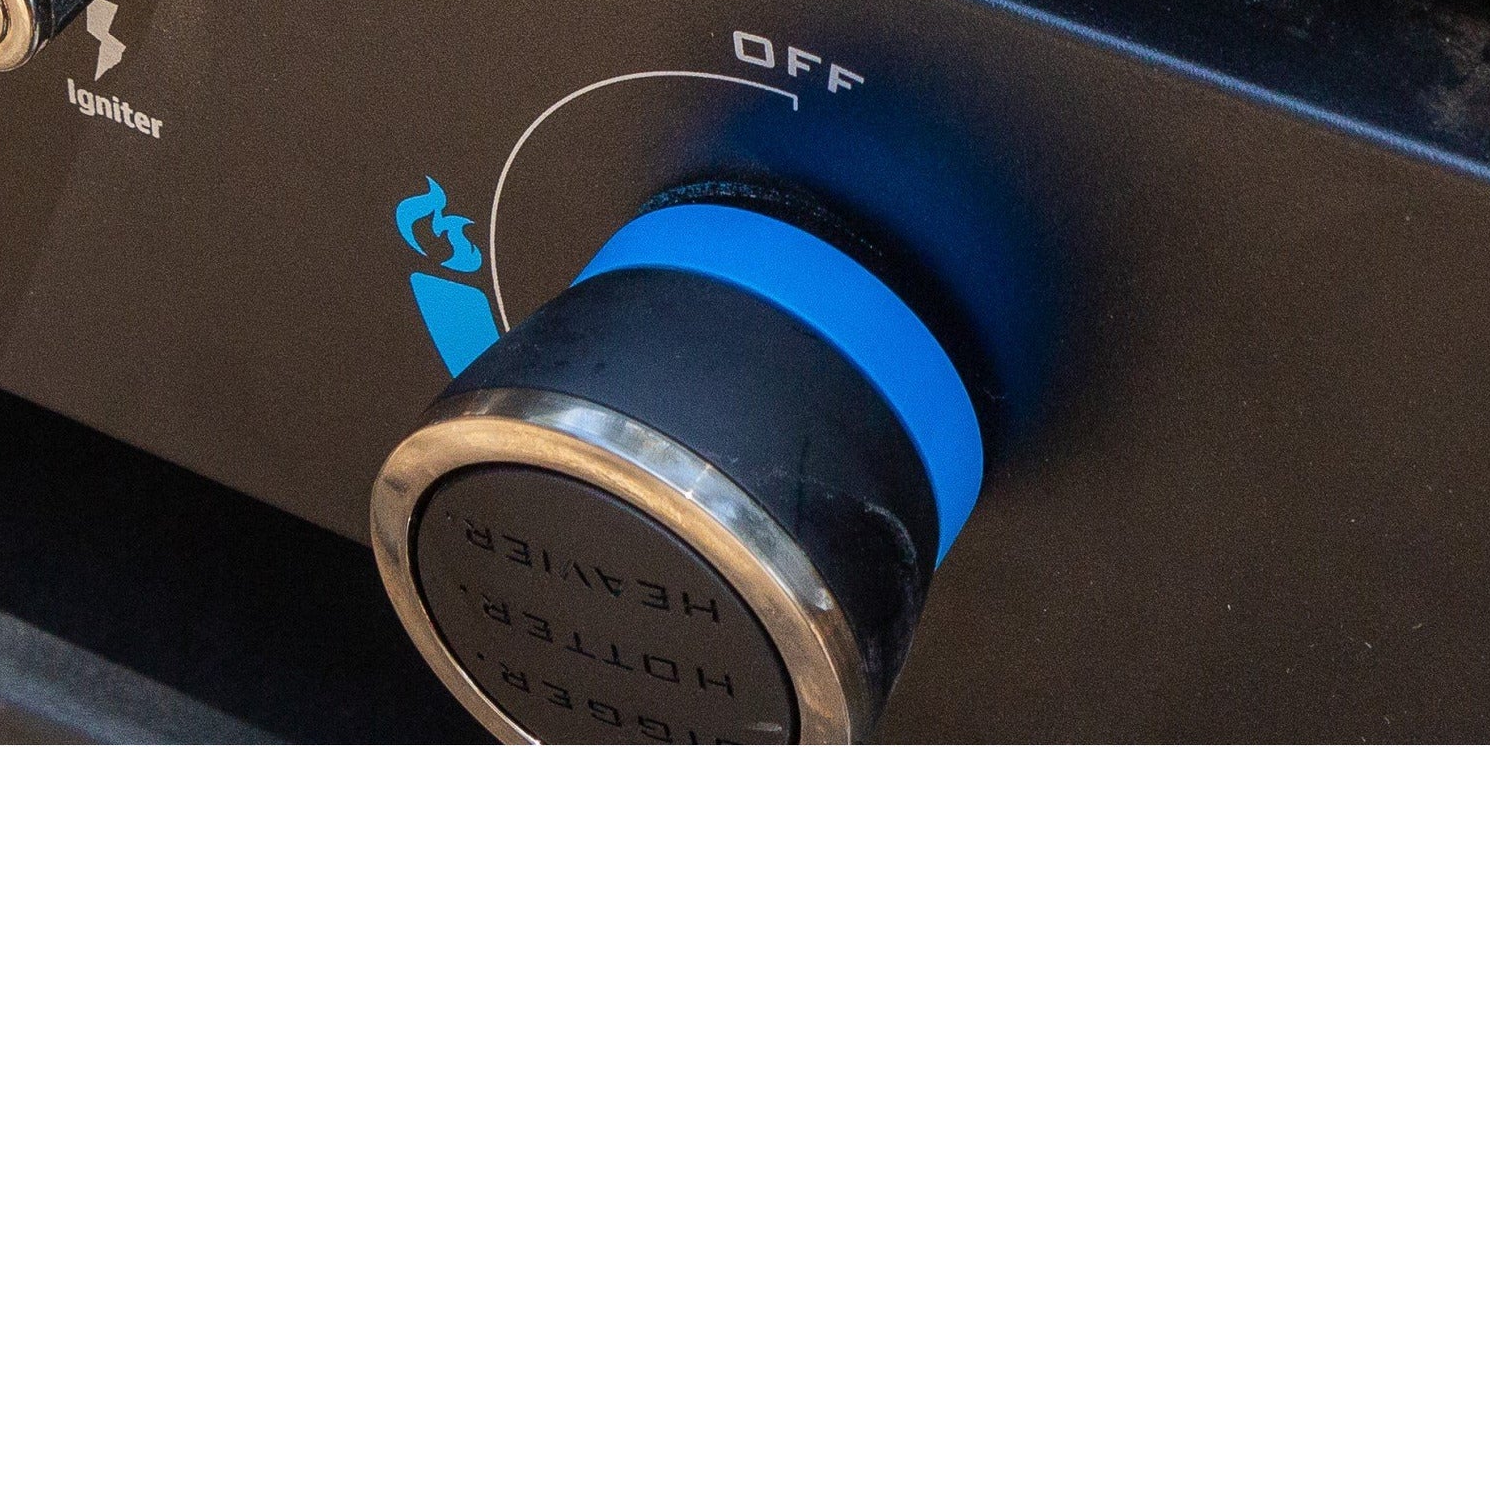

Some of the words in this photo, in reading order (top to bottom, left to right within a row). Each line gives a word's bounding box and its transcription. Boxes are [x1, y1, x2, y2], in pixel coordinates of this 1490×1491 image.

[732, 30, 865, 94] OFF
[67, 78, 163, 139] Igniter
[446, 511, 720, 623] HEAVIER.
[460, 583, 735, 697] HOTTER.
